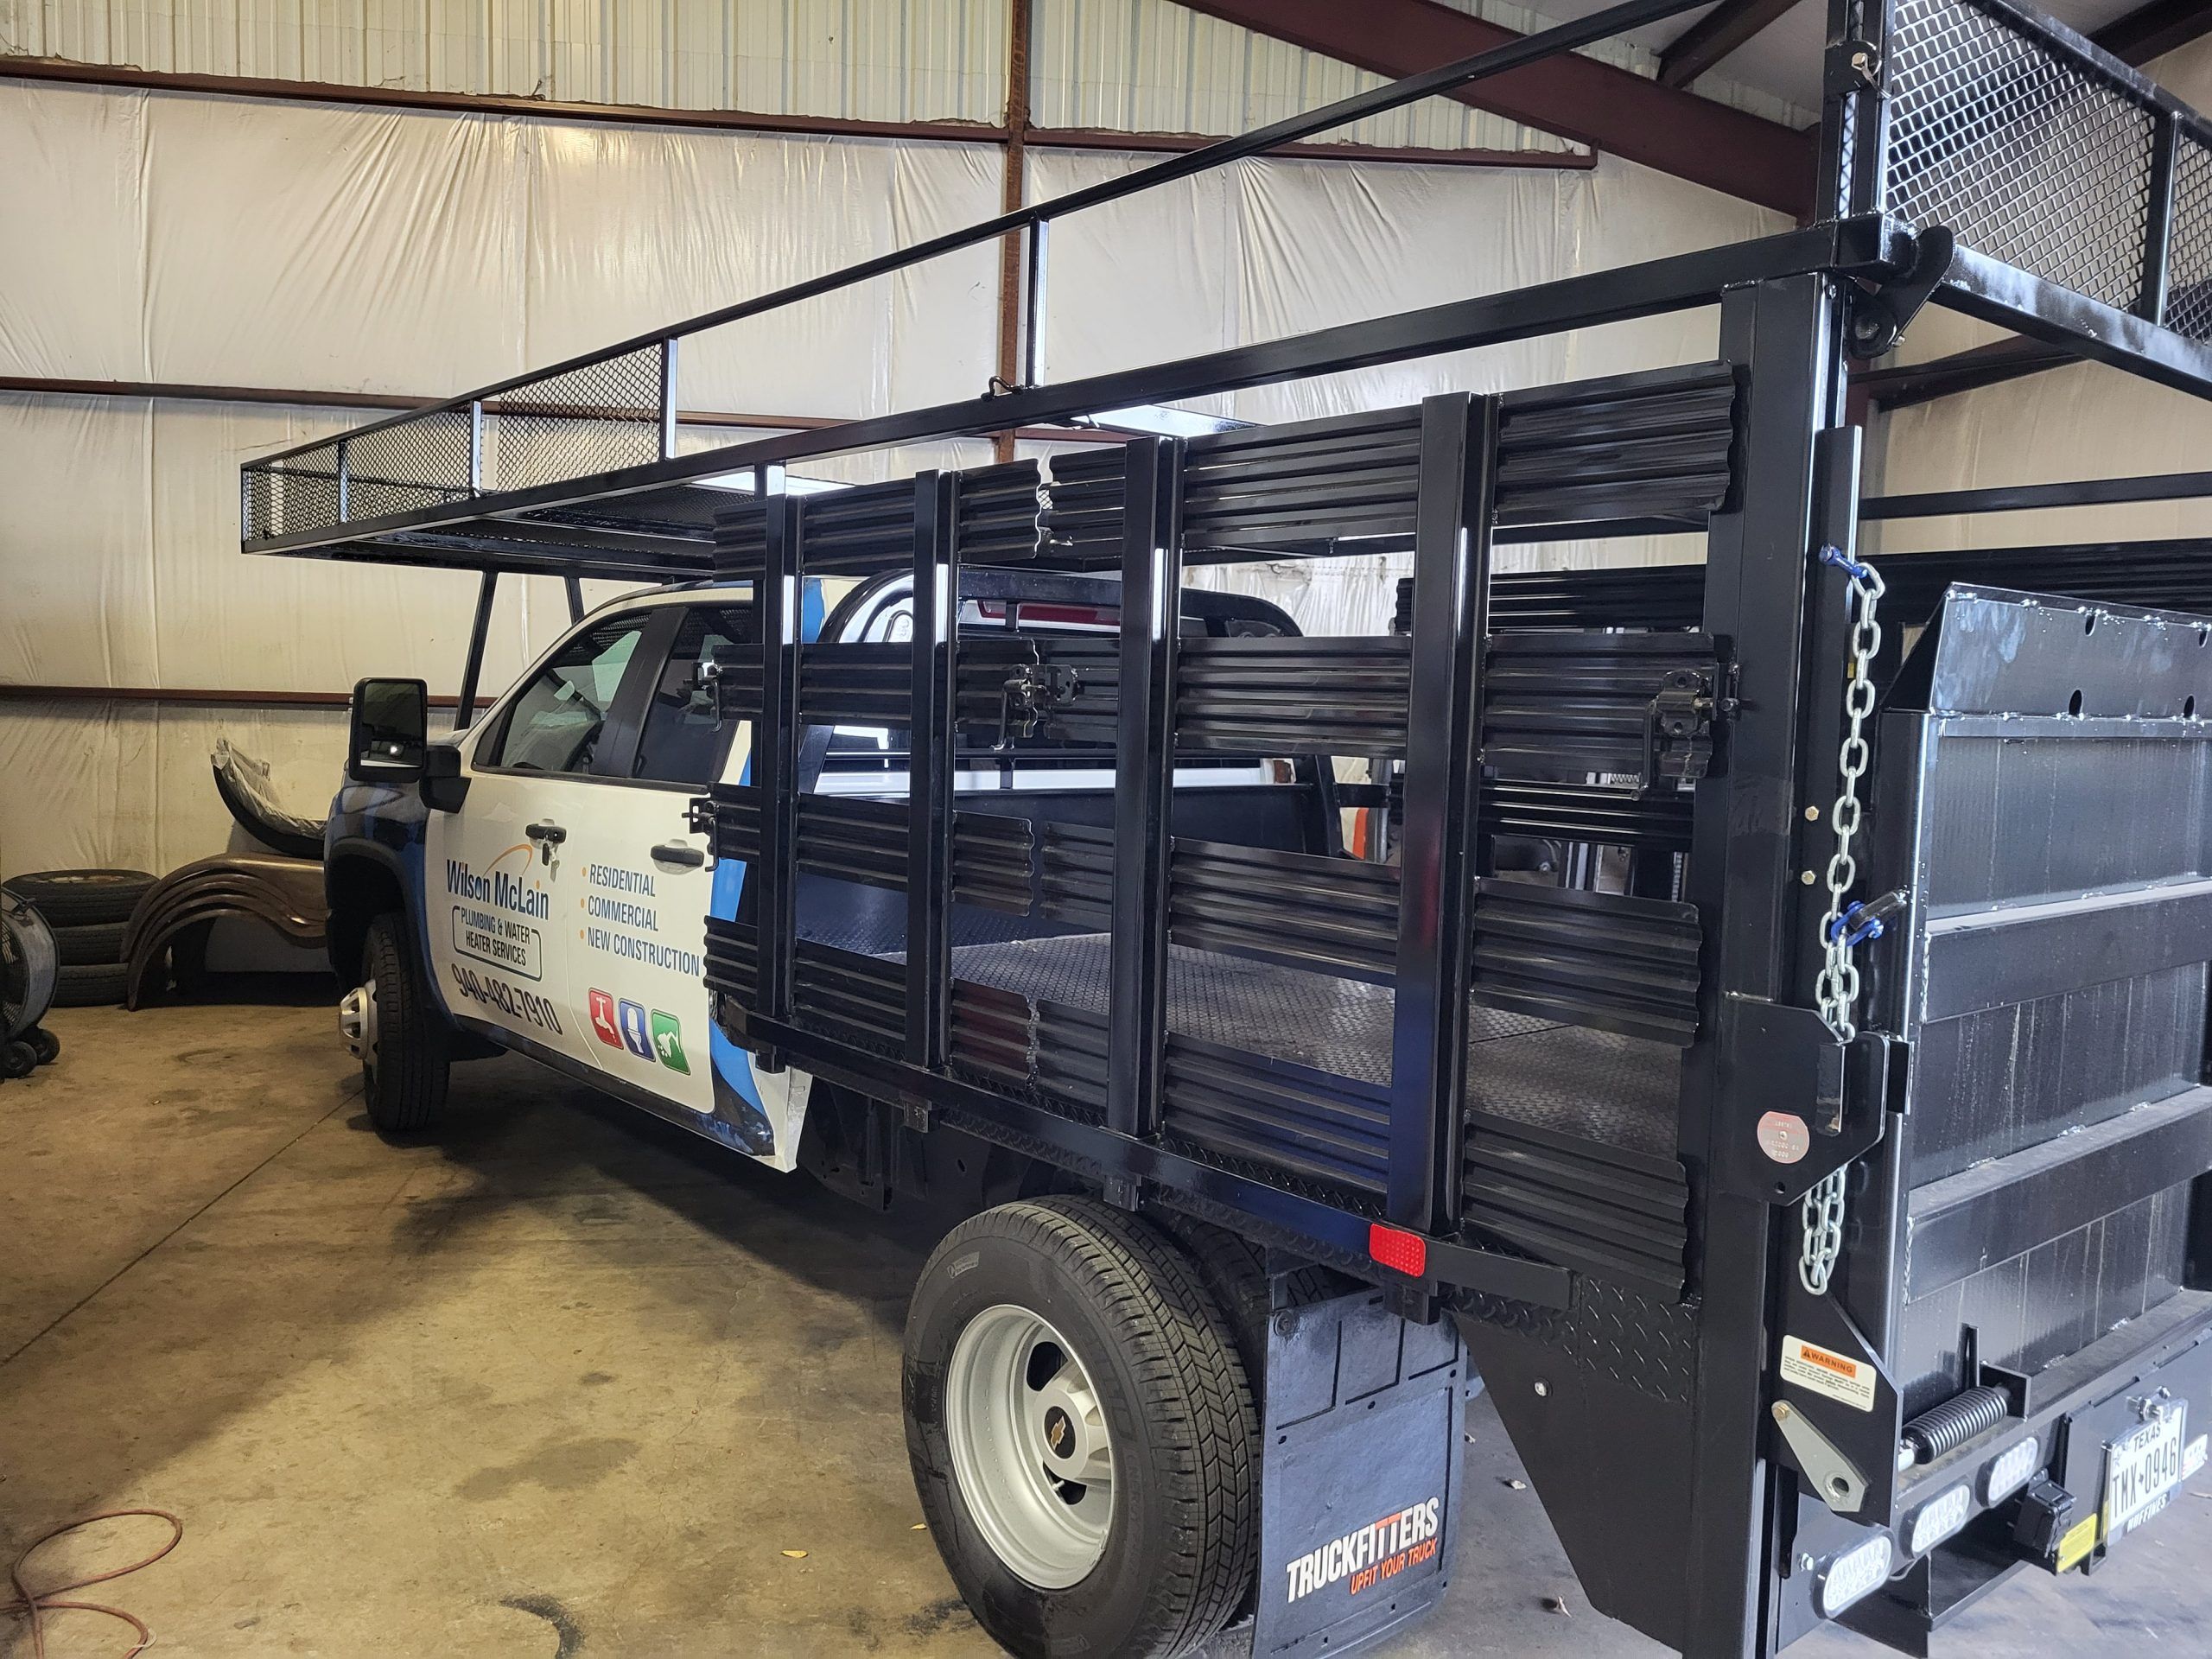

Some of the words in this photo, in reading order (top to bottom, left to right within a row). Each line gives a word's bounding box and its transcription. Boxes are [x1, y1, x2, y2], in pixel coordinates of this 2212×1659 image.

[447, 859, 491, 903] Wilson
[494, 871, 549, 921] McLain
[589, 864, 656, 897] RESIDENTIAL
[461, 907, 496, 933] PLUMBING
[497, 918, 503, 936] &
[505, 920, 531, 944] WATER
[588, 895, 658, 931] COMMERCIAL
[466, 930, 492, 954] HEATER
[493, 938, 526, 966] SERVICES
[588, 926, 611, 951] NEW
[613, 934, 700, 976] CONSTRUCTION
[451, 963, 563, 1035] 940-482-7910
[1810, 1352, 1853, 1374] WARNING
[2133, 1424, 2161, 1452] TEXAS
[1286, 1497, 1440, 1604] TRUCKFITTERS
[1350, 1564, 1378, 1596] UPFIT
[1380, 1553, 1406, 1580] YOUR
[1408, 1537, 1438, 1567] TRUCK
